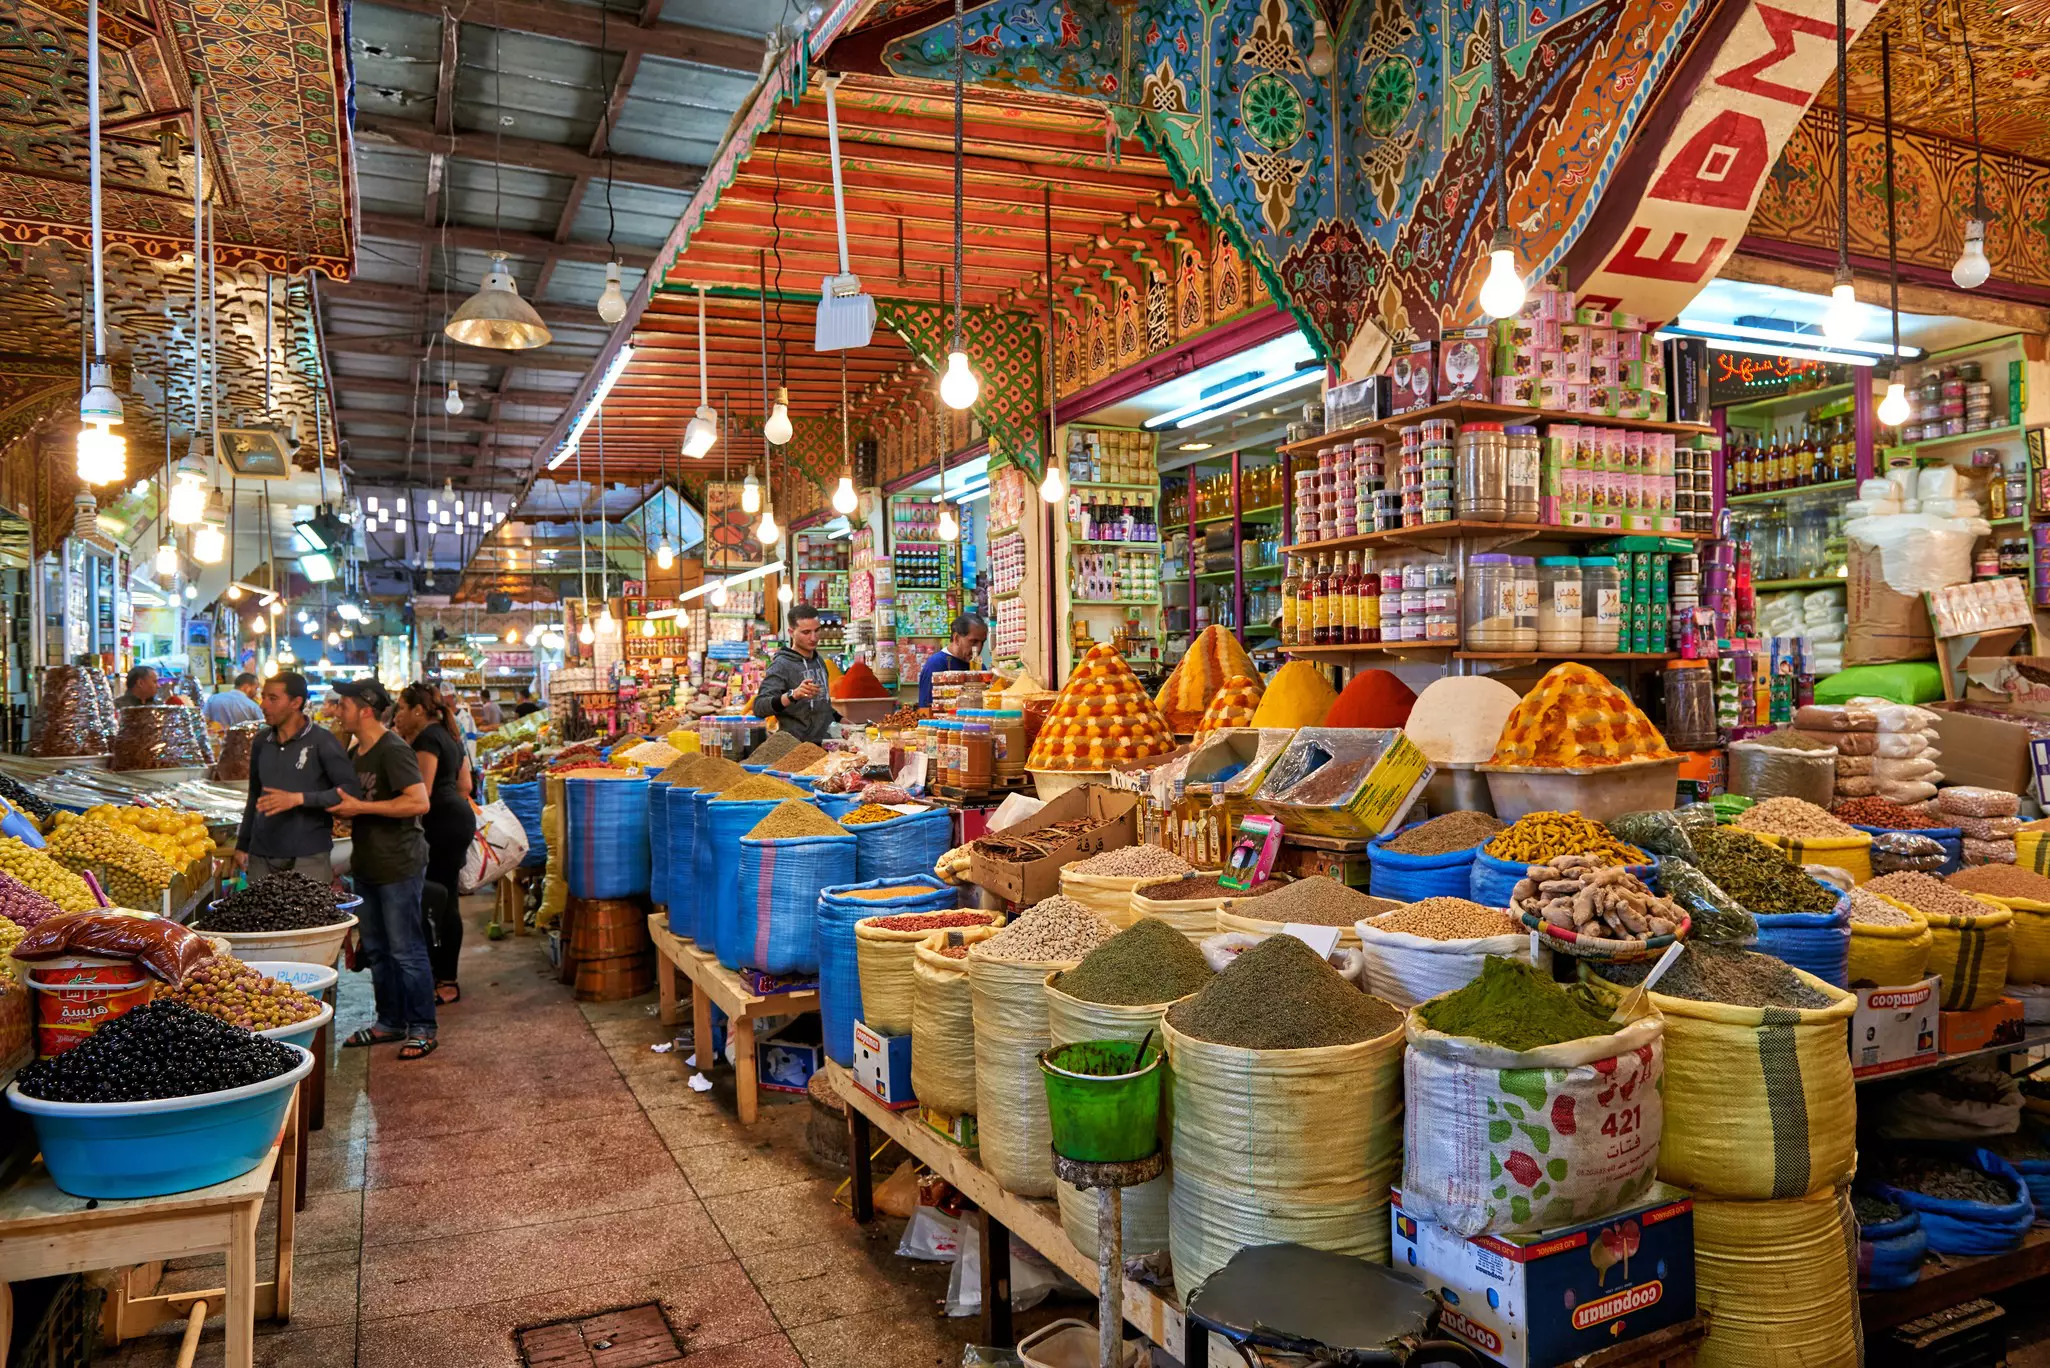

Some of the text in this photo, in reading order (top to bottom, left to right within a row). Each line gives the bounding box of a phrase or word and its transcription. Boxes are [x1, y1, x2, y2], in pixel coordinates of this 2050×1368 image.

[1076, 836, 1104, 856] قرفة
[61, 1005, 109, 1018] هريسة
[1600, 1103, 1641, 1138] 421
[1675, 1204, 1686, 1216] AJO
[1501, 1246, 1516, 1257] AJO
[1563, 1239, 1576, 1249] AJO
[1578, 1285, 1658, 1327] coopaman
[1440, 1309, 1496, 1350] coopa
